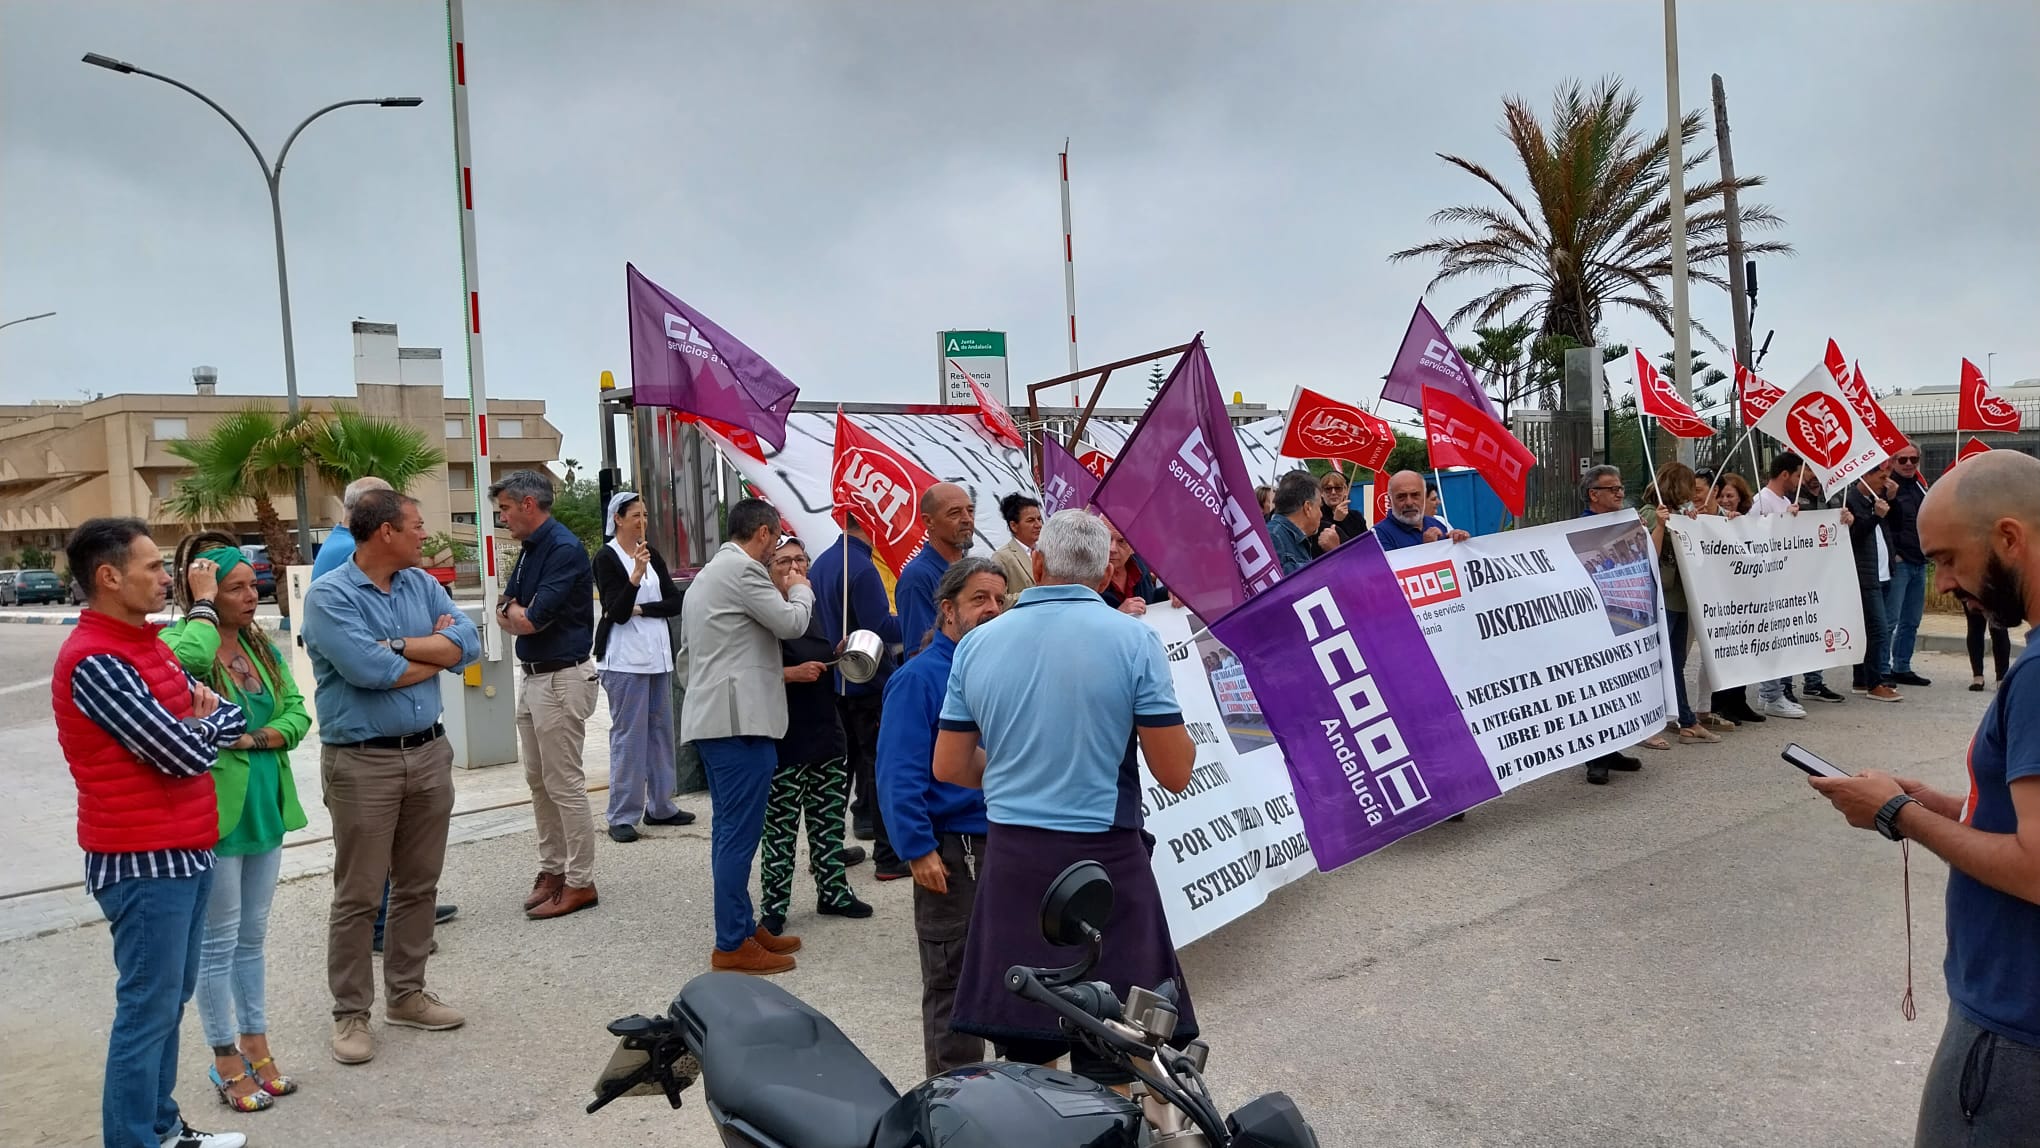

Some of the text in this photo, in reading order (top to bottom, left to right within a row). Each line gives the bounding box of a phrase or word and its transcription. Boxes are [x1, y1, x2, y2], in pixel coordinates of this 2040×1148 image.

[668, 341, 709, 359] servicios
[711, 354, 718, 363] a
[1420, 357, 1455, 377] servicios
[951, 372, 991, 380] Resencia
[951, 391, 971, 399] Libre
[1311, 410, 1364, 437] UGT
[1806, 396, 1849, 451] UGT
[843, 452, 911, 526] UGT
[1168, 459, 1220, 515] servicios
[1511, 552, 1538, 576] YA
[1530, 548, 1555, 574] DE
[1783, 537, 1792, 550] La
[1793, 535, 1814, 550] Línea
[1423, 611, 1432, 621] de
[1434, 602, 1466, 618] servicios
[1475, 586, 1598, 640] DISCRIMINACION!
[1703, 603, 1716, 619] Por
[1717, 602, 1723, 616] la
[1723, 600, 1768, 616] cobertura
[1775, 594, 1807, 610] vacantes
[1807, 590, 1819, 605] YA
[1714, 620, 1755, 641] ampliación
[1757, 619, 1769, 633] de
[1792, 613, 1804, 626] en
[1804, 610, 1818, 624] los
[1714, 643, 1739, 659] ntratos
[1740, 641, 1748, 654] de
[1750, 639, 1769, 657] fijos
[1771, 631, 1822, 650] discontinuos.
[1292, 586, 1410, 772] CCOO
[1466, 670, 1543, 707] NECESITA
[1546, 642, 1634, 683] INVERSIONES
[1634, 639, 1642, 655] Y
[1482, 698, 1552, 732] INTEGRAL
[1555, 690, 1577, 709] DE
[1579, 684, 1598, 702] LA
[1598, 665, 1650, 694] RESIDENCIA
[1497, 690, 1643, 751] LIBRE DE LA LINEA YA!
[1496, 761, 1513, 781] DE
[1514, 743, 1565, 772] TODAS
[1568, 734, 1595, 754] LAS
[1598, 717, 1640, 744] PLAZAS
[1319, 718, 1383, 827] Andalucía
[1168, 827, 1213, 864] POR
[1208, 815, 1238, 842] UN
[1264, 796, 1295, 825] QUE
